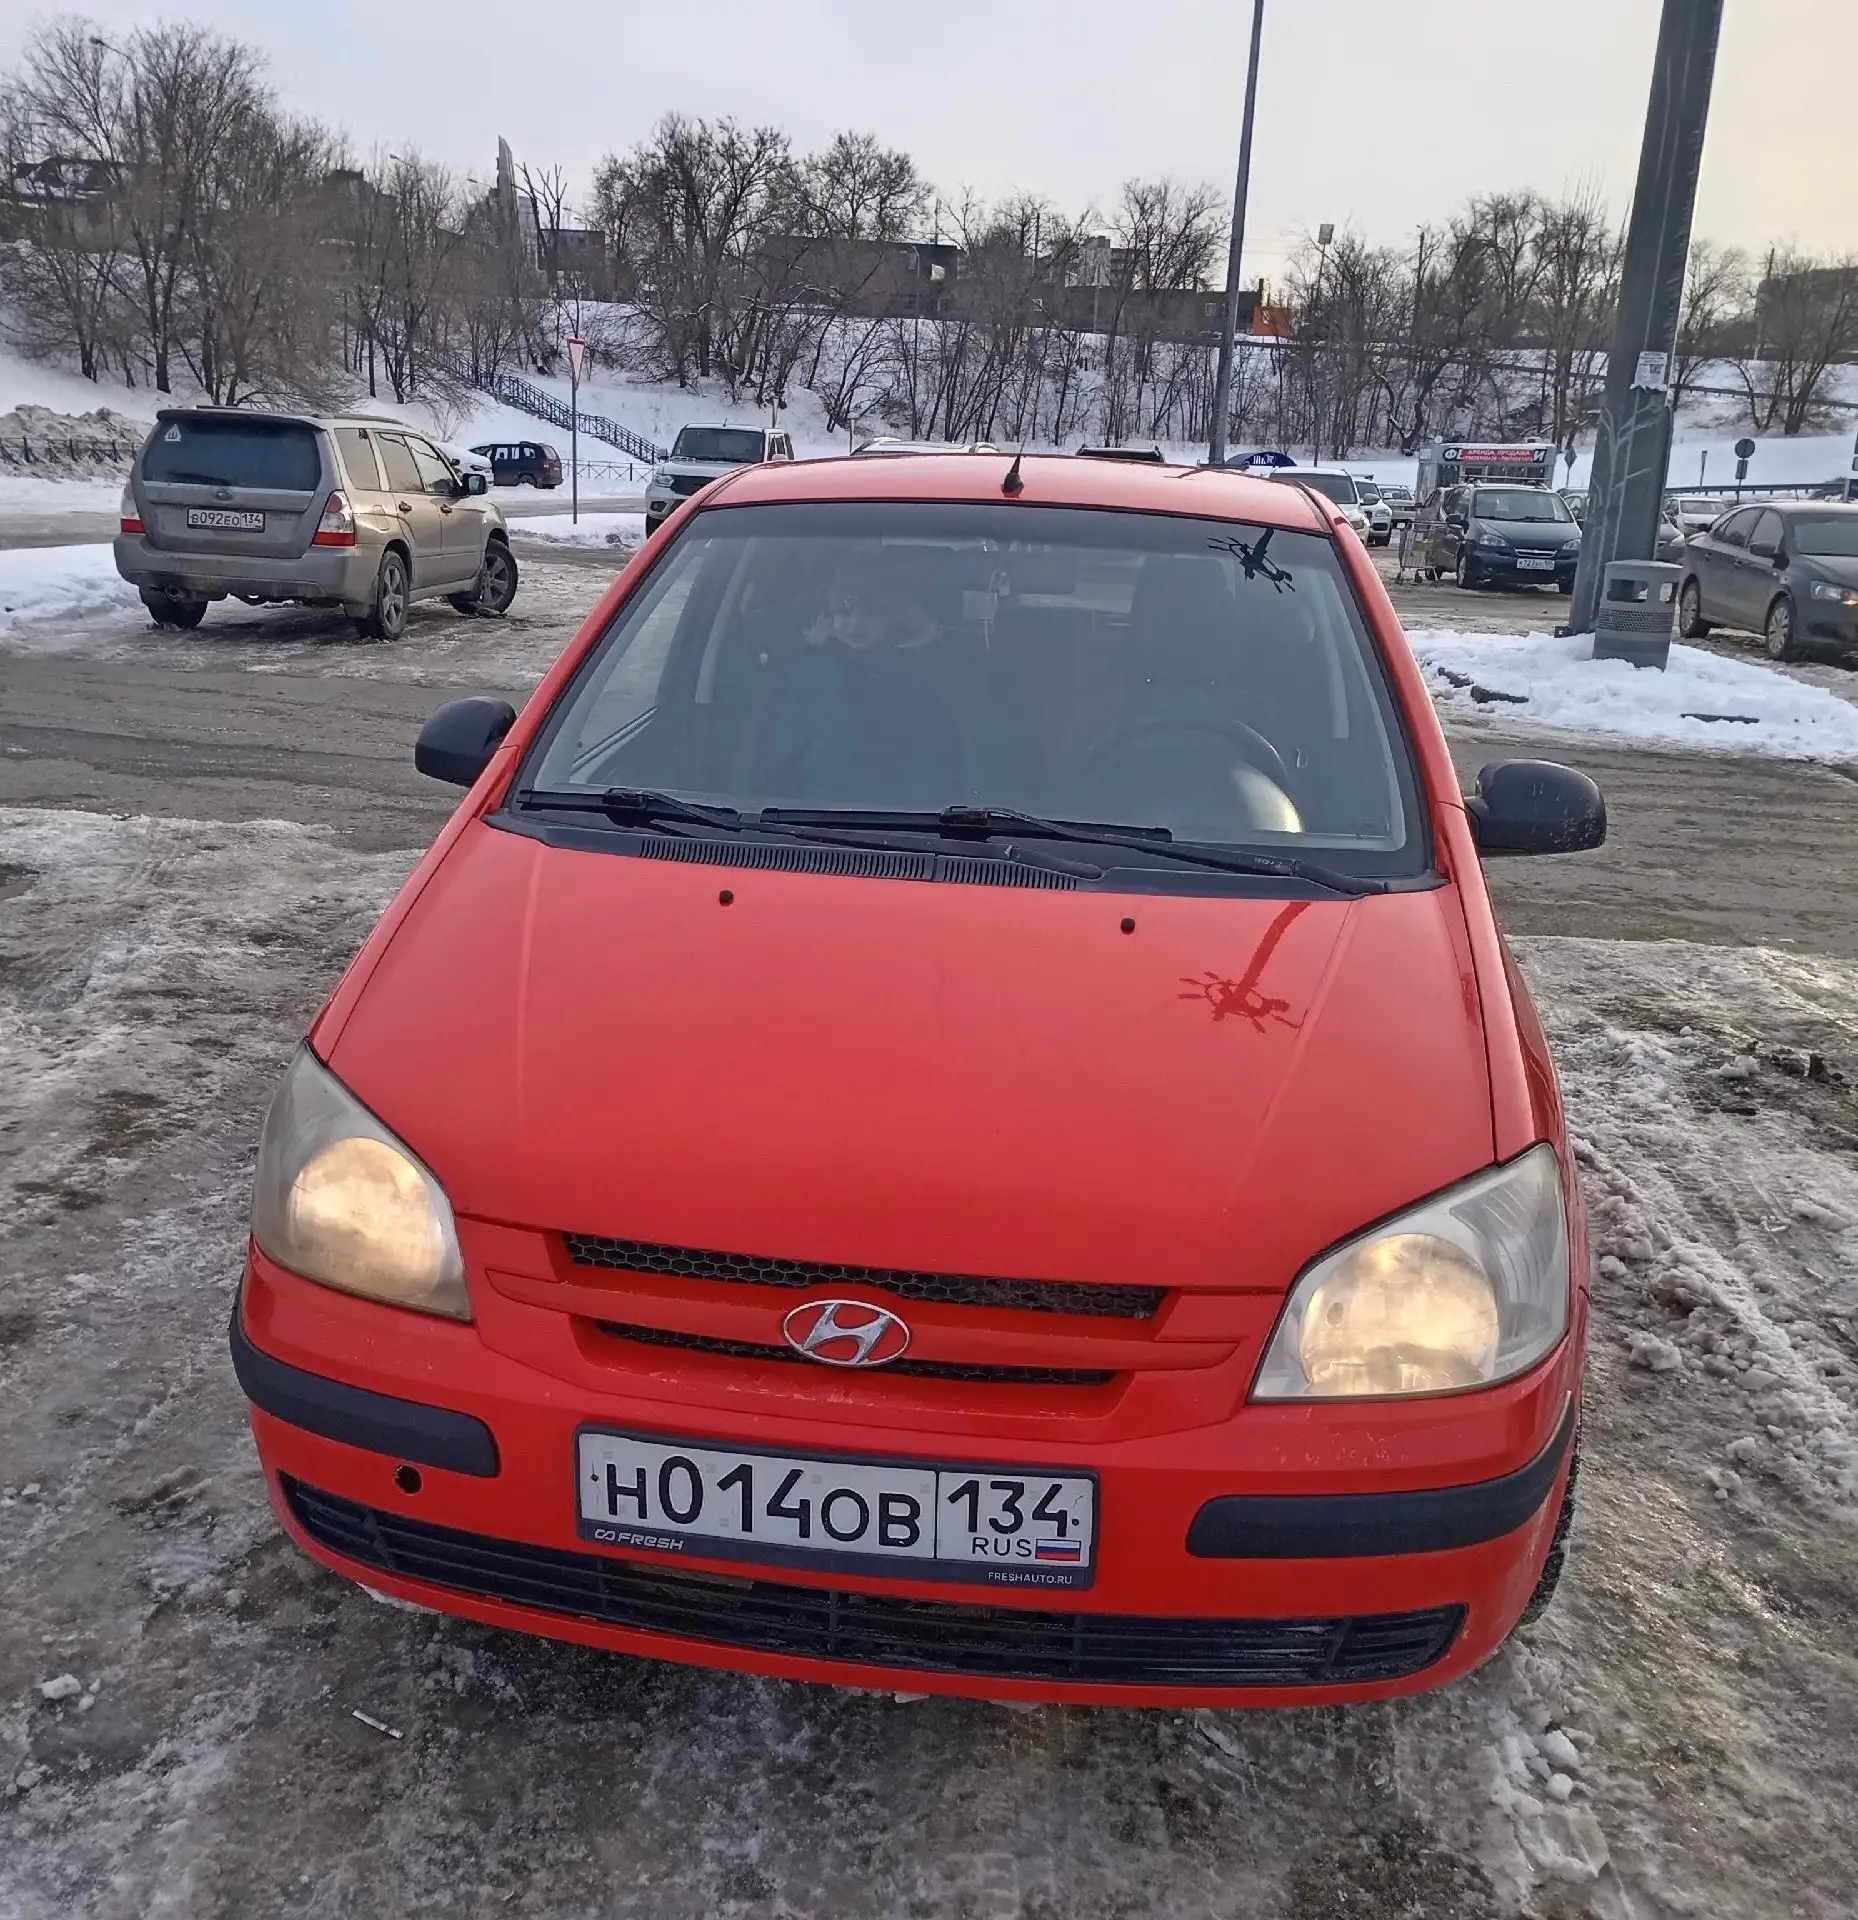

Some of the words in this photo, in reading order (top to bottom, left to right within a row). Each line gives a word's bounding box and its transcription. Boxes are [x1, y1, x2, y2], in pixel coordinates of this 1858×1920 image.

[190, 511, 240, 526] В092ЕО
[242, 513, 261, 524] 134
[605, 1455, 922, 1548] Н014ОВ
[946, 1479, 1069, 1538] 134
[617, 1531, 685, 1551] FRESH
[971, 1536, 1033, 1558] RUS
[987, 1570, 1074, 1586] FRESHAUTO.RU
